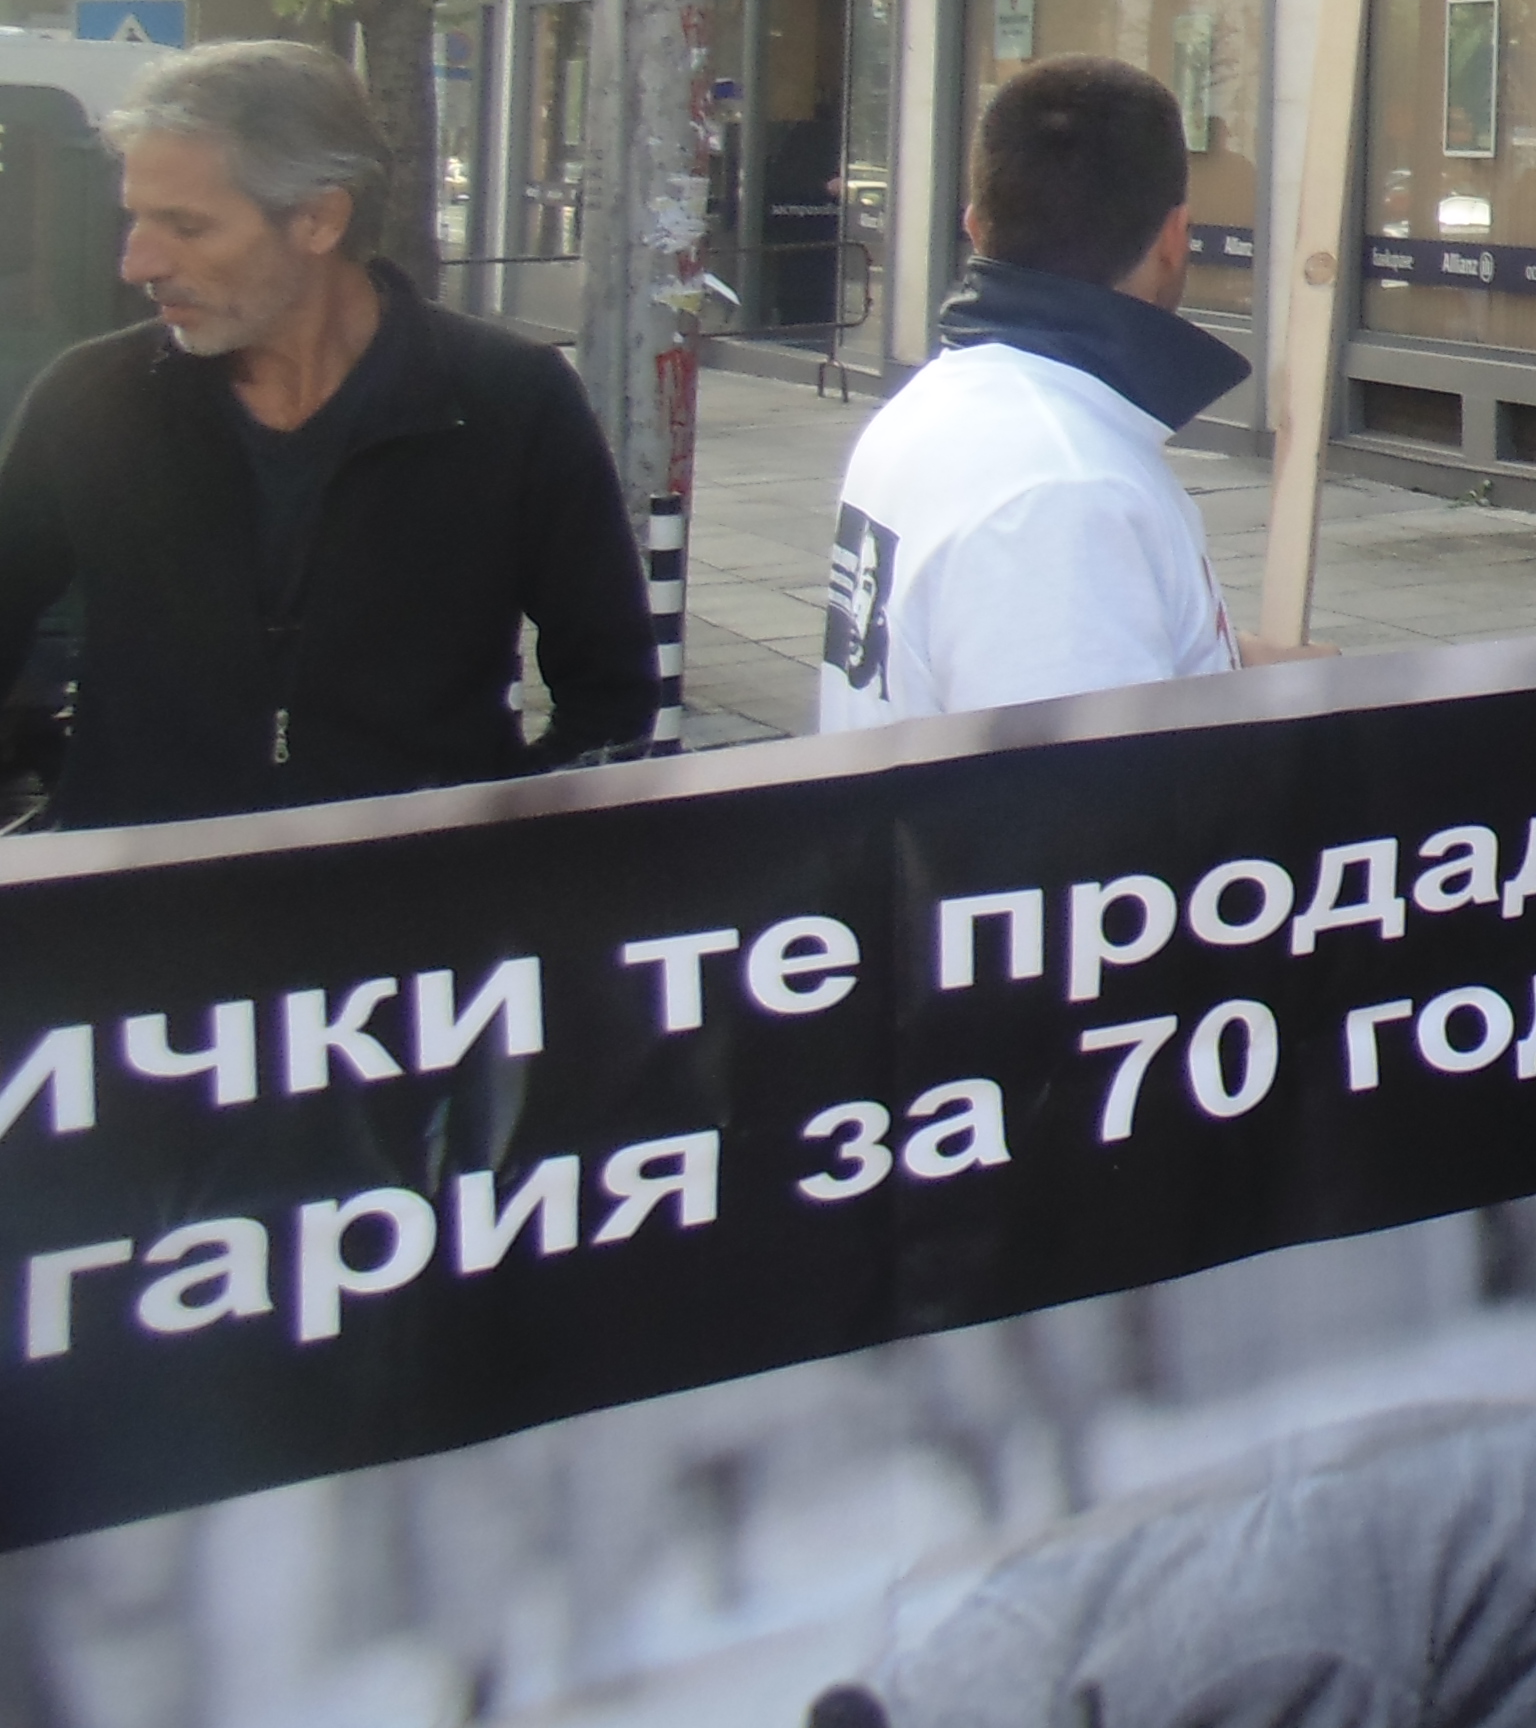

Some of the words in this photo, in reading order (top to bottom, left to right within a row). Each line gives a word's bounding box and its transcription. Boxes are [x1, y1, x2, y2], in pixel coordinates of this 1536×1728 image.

[623, 914, 861, 1033] те
[26, 1129, 722, 1361] гария
[799, 1076, 1013, 1200] за
[1080, 998, 1280, 1142] 70
